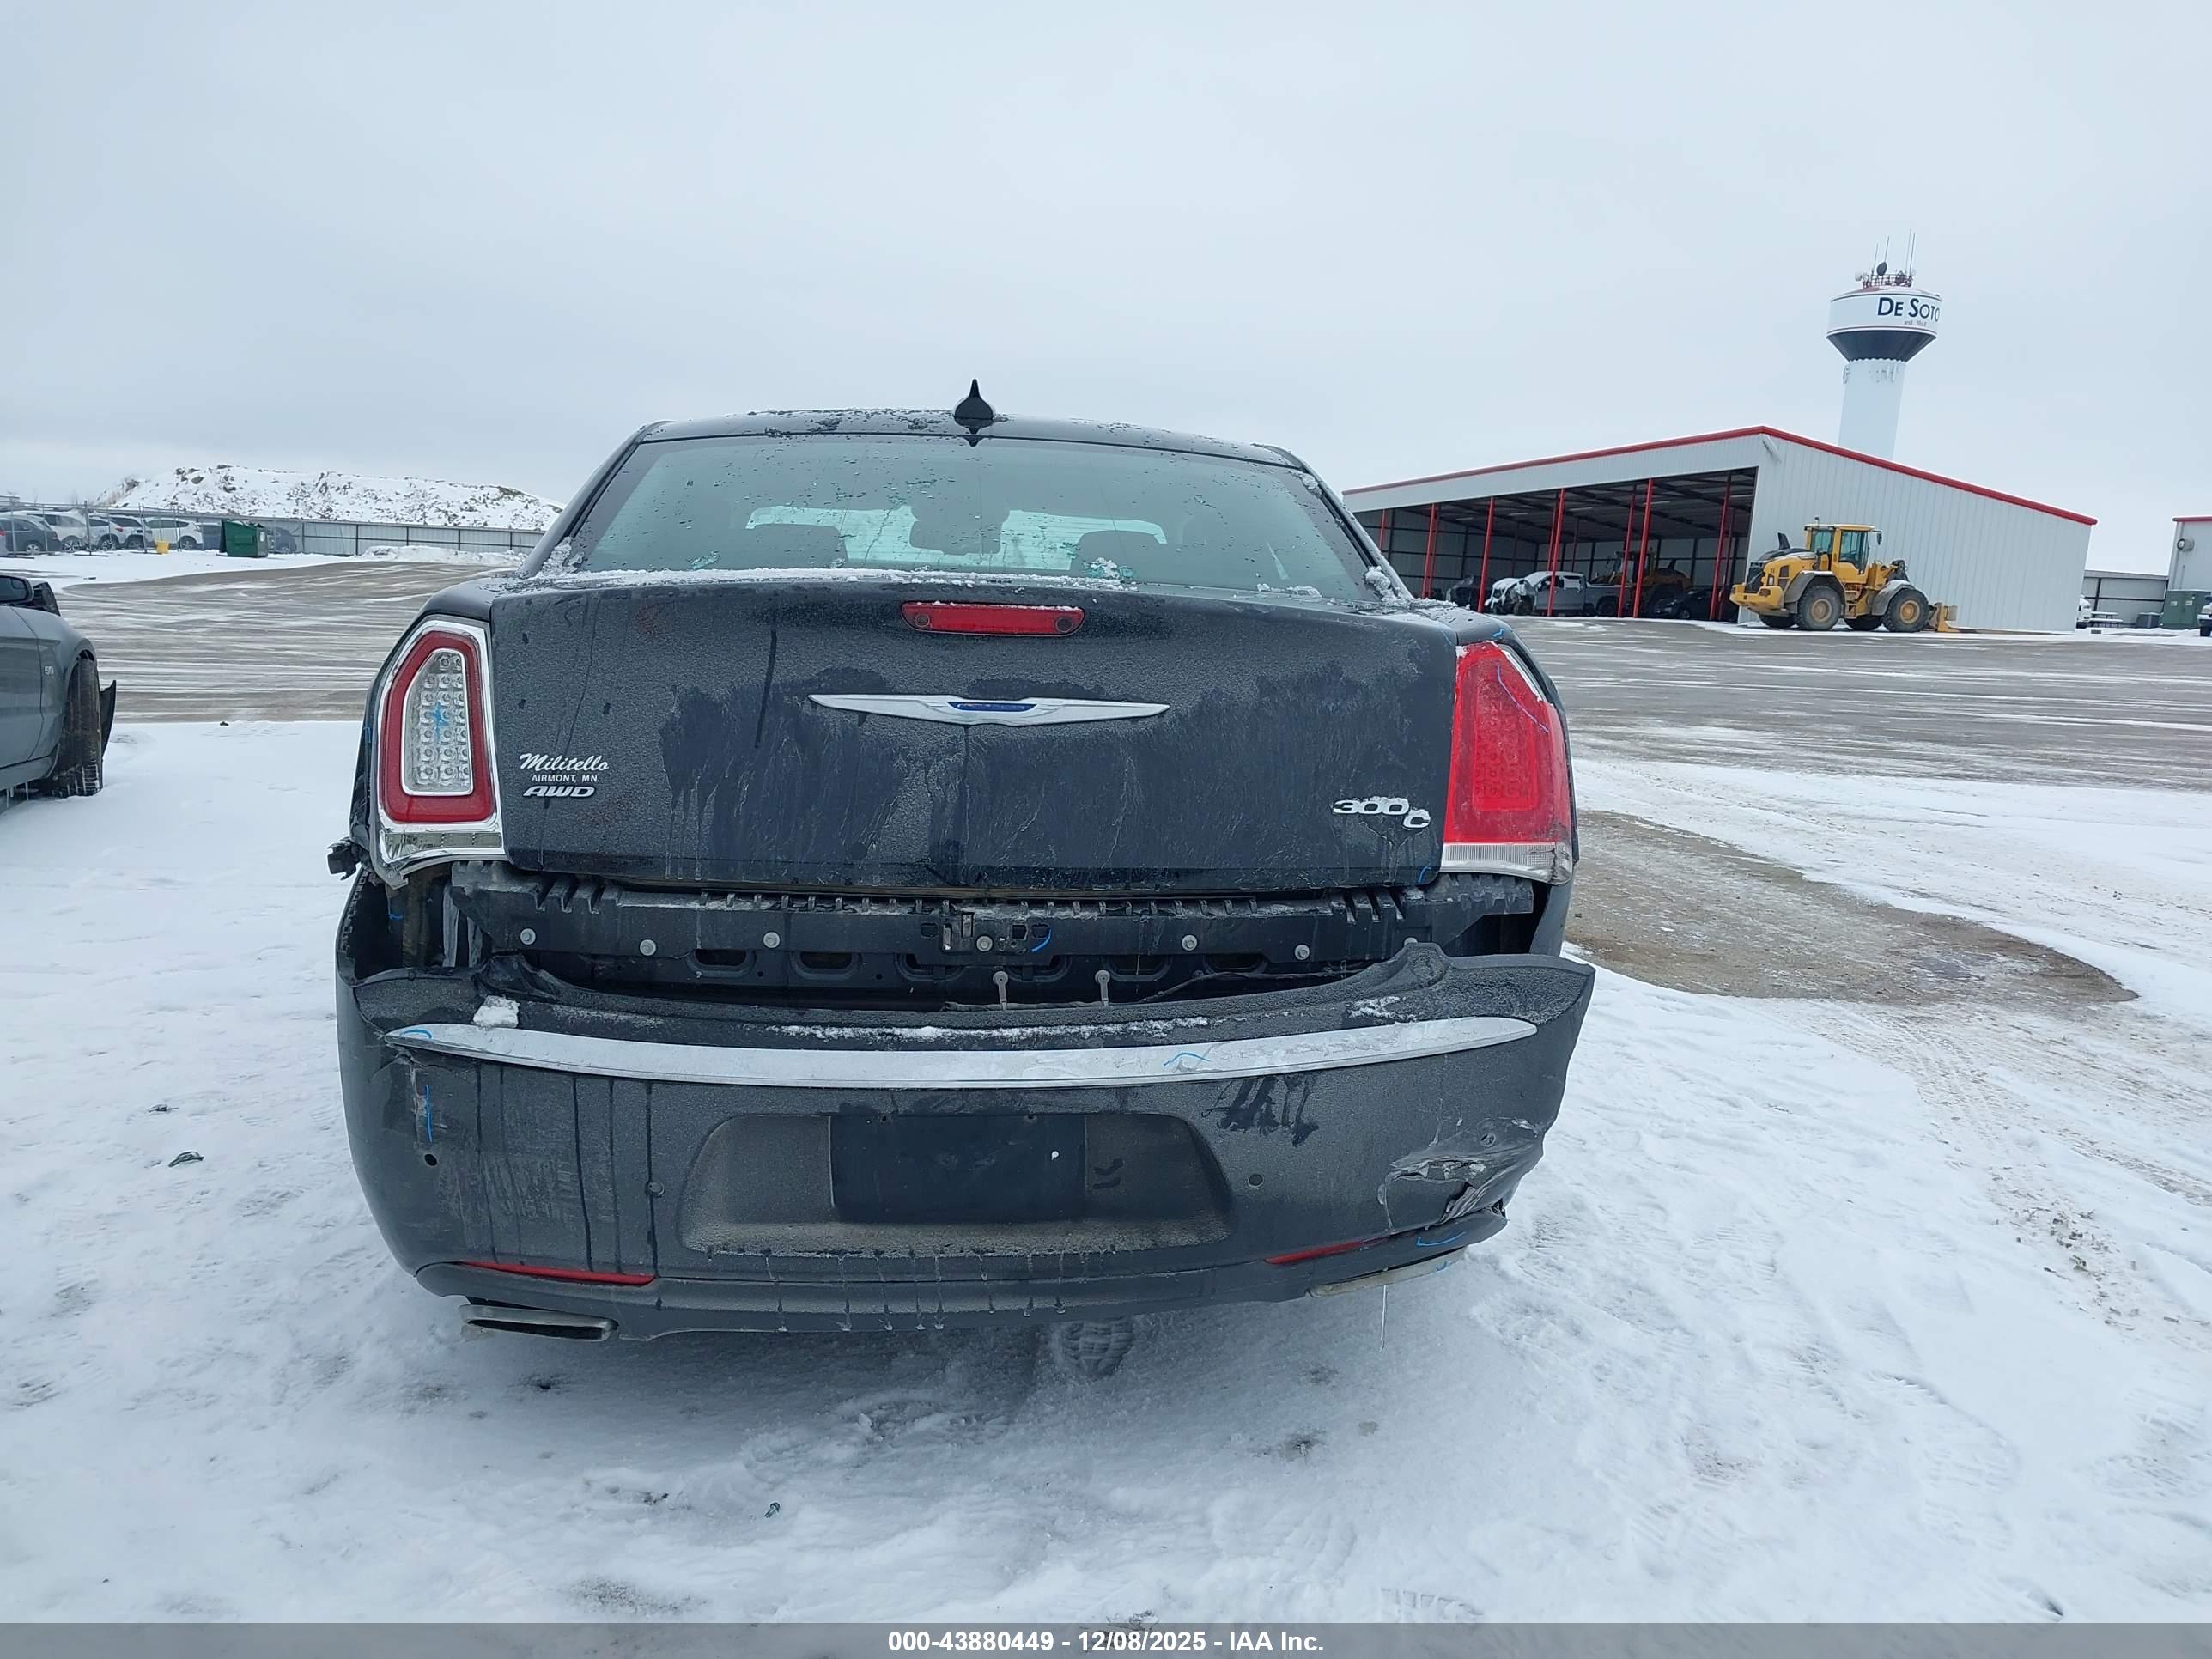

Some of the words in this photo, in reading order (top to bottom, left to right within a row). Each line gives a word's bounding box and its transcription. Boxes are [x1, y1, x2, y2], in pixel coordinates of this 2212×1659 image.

[519, 752, 610, 771] Militello
[522, 785, 596, 798] AWD
[1332, 796, 1431, 829] 300C
